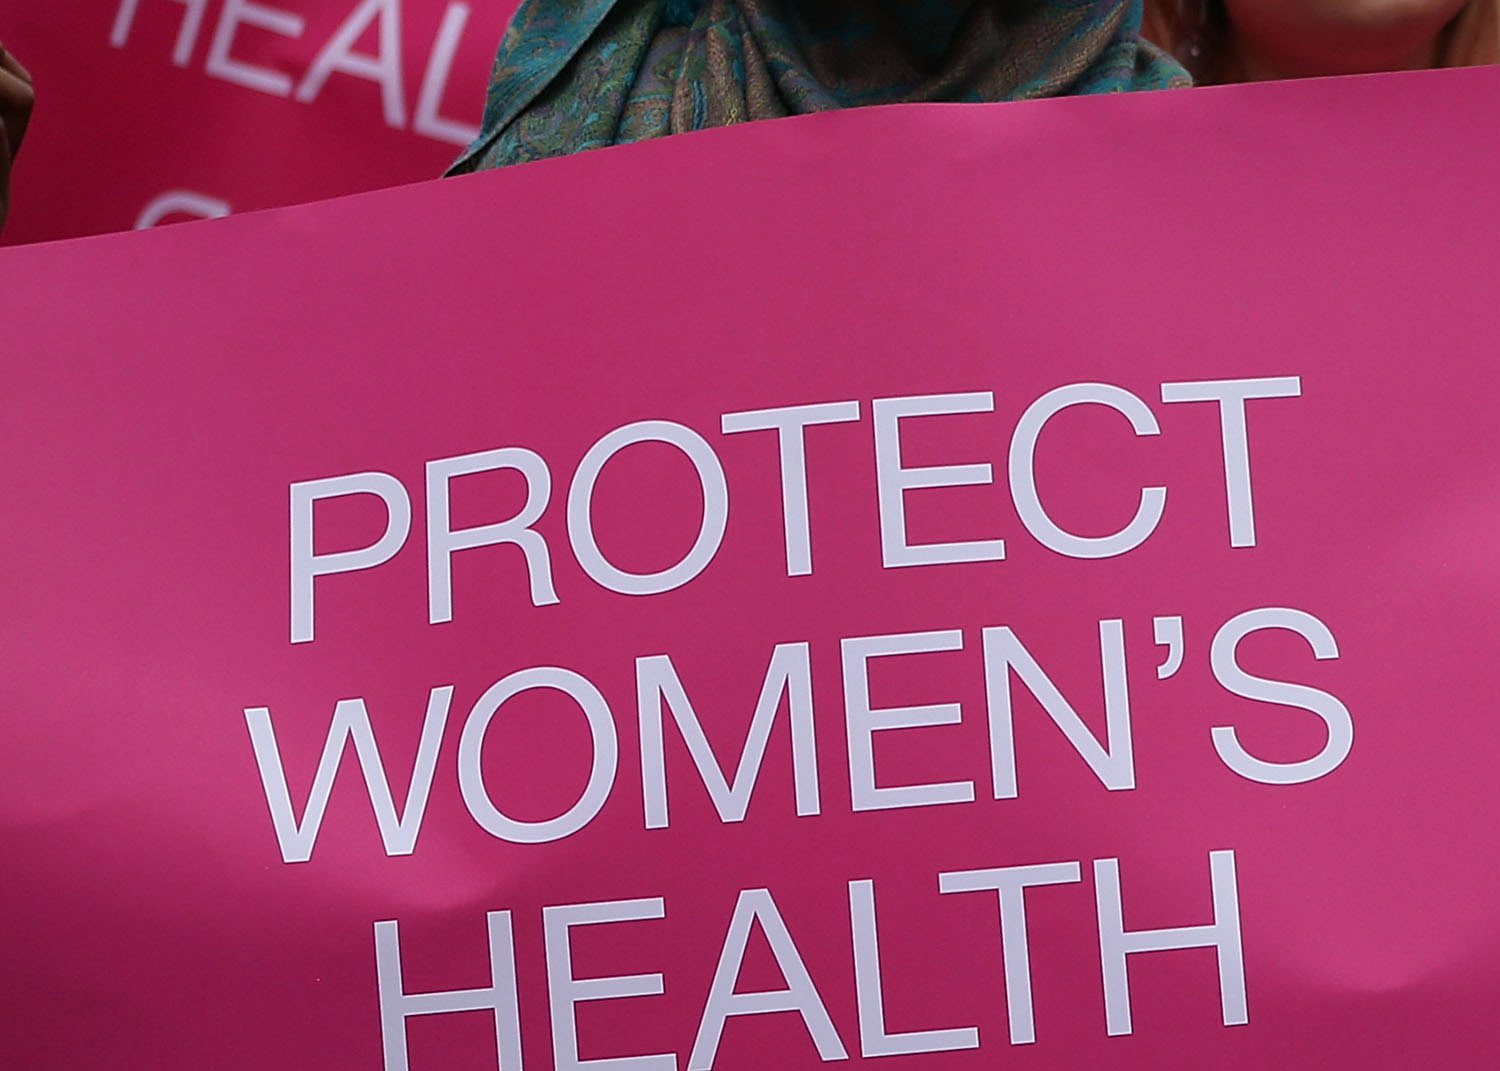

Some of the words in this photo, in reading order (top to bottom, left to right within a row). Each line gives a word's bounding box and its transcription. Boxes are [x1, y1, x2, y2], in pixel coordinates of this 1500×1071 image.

[288, 375, 1303, 645] PROTECT
[242, 607, 1355, 864] WOMEN'S
[373, 849, 1250, 1071] HEALTH
